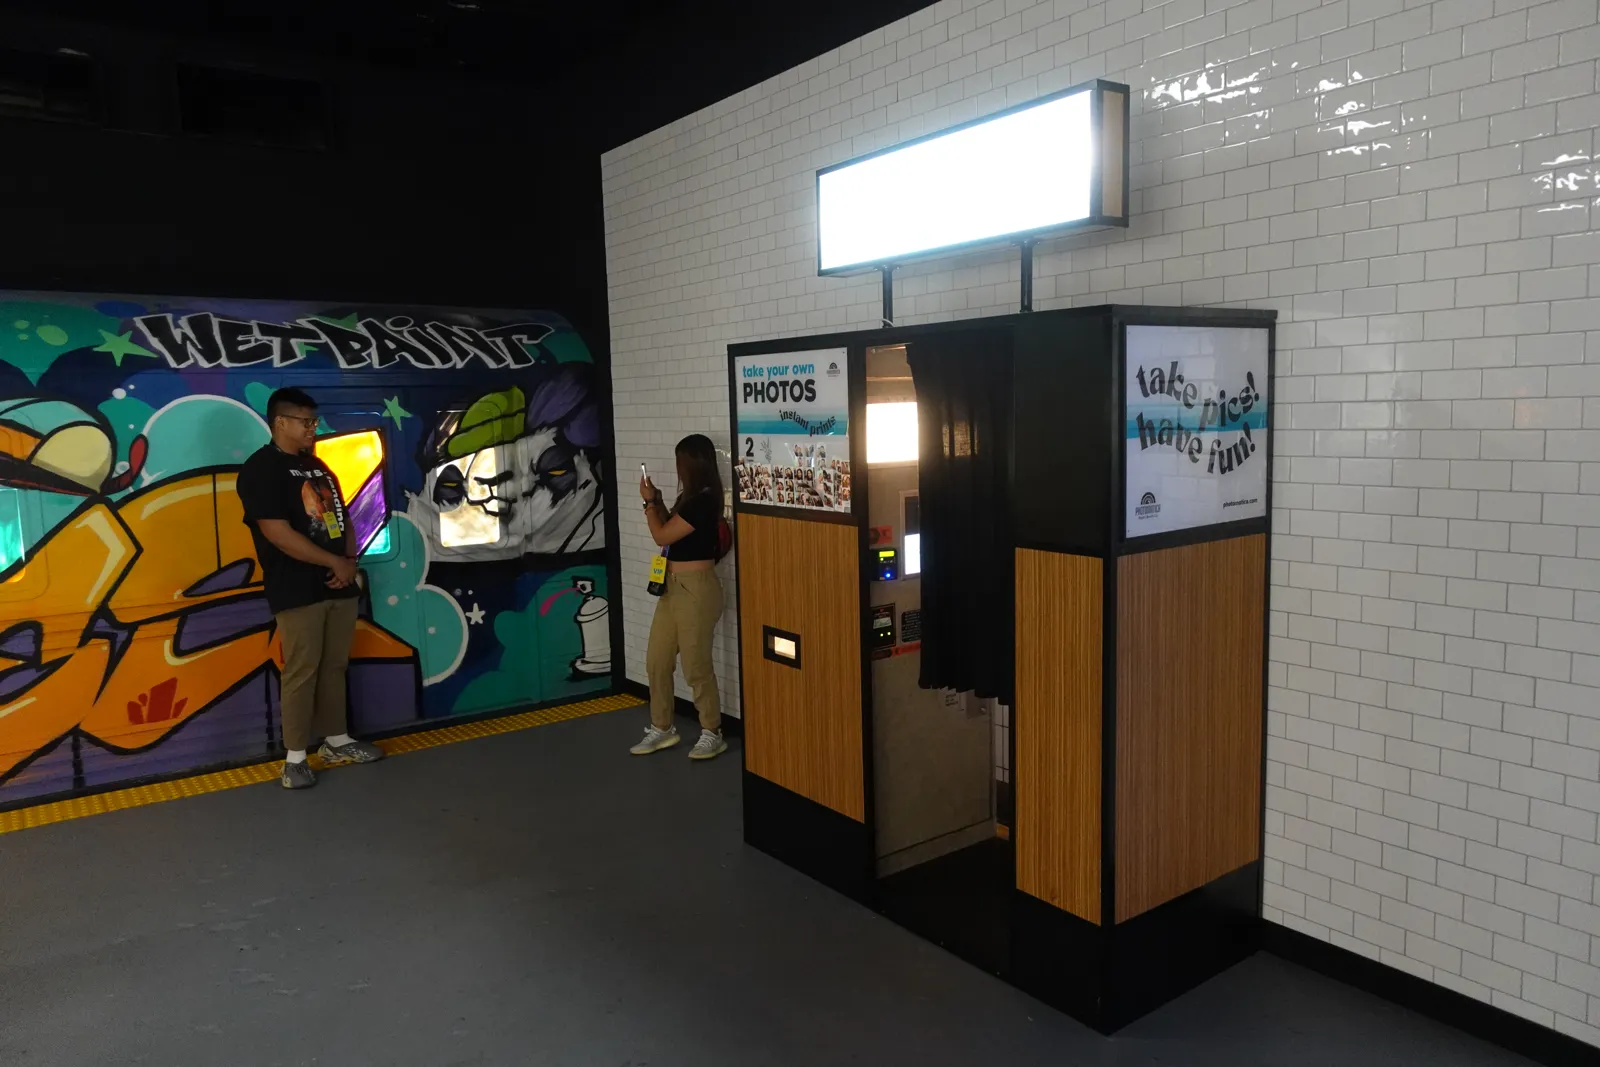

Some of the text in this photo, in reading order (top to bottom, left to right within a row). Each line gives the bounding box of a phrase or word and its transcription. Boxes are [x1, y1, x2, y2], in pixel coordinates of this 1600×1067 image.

[134, 312, 322, 368] WET
[743, 364, 764, 378] take
[767, 365, 790, 380] your
[793, 364, 815, 376] own
[743, 379, 816, 403] PHOTOS
[1136, 361, 1260, 432] take pics!
[779, 409, 837, 437] instant prints
[745, 437, 754, 457] 2
[1136, 412, 1256, 475] have fun!
